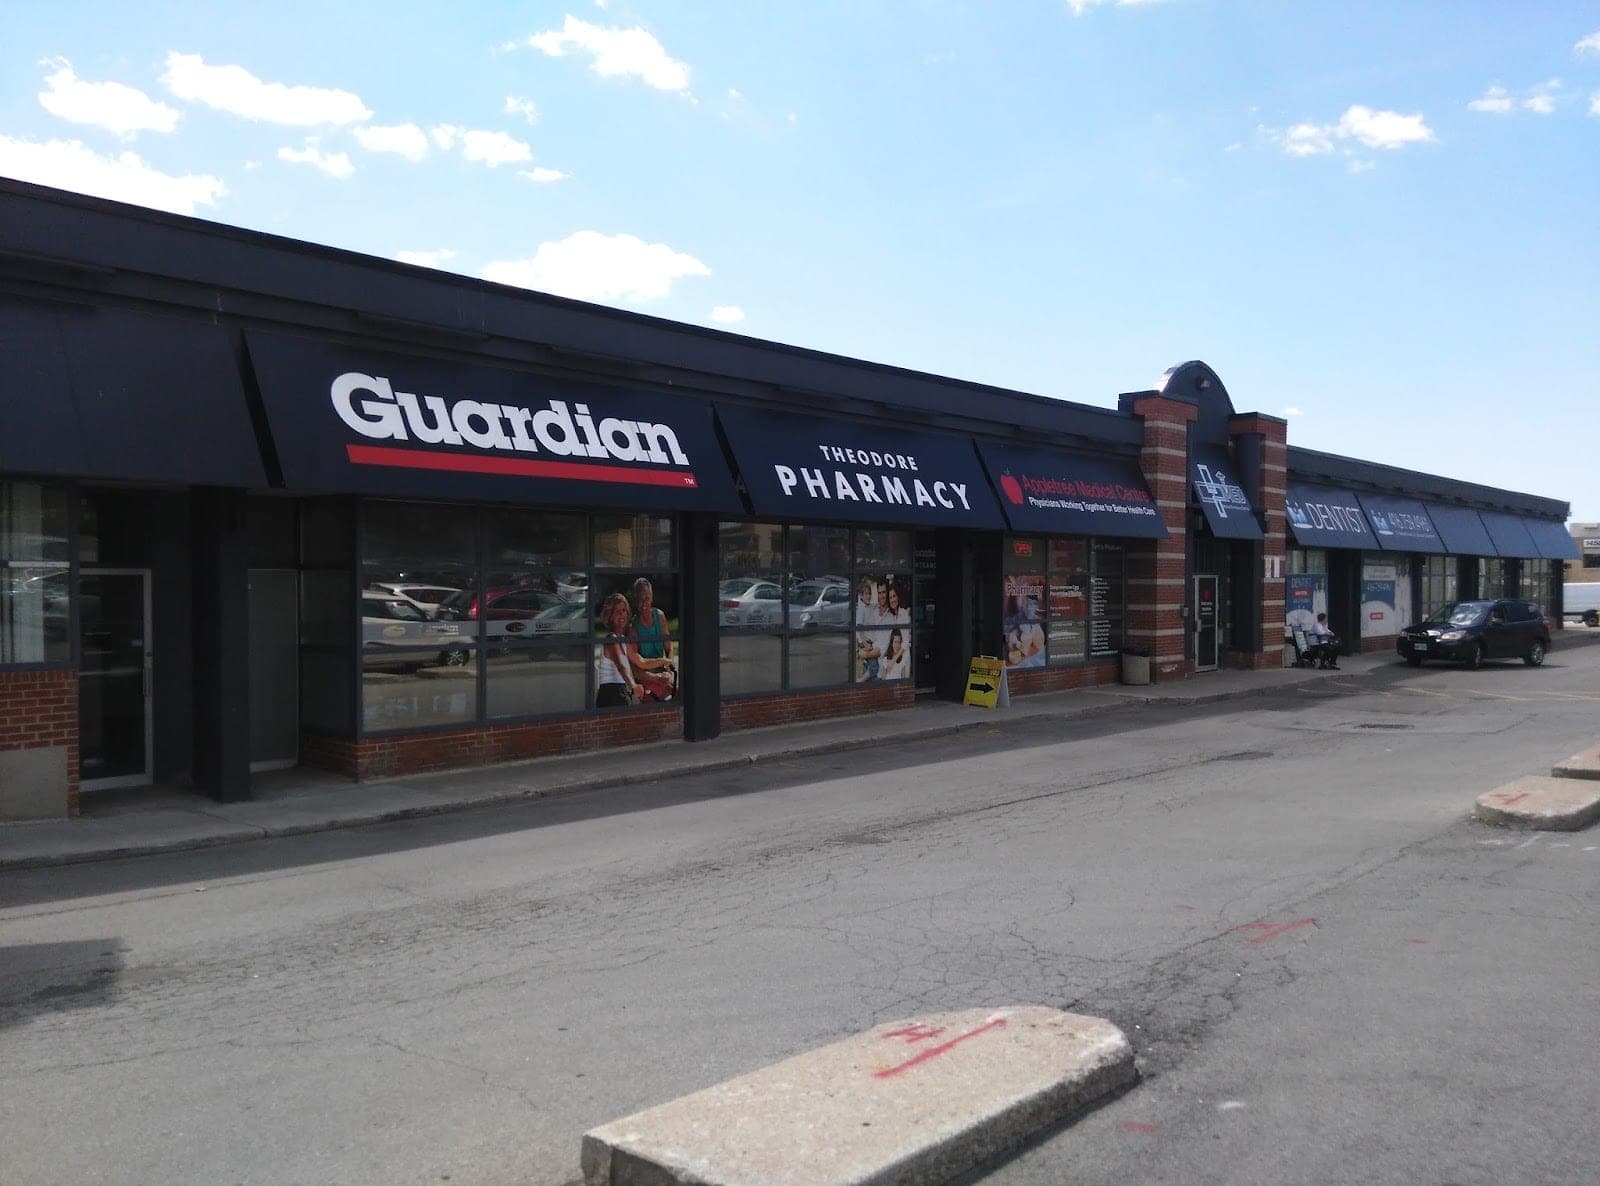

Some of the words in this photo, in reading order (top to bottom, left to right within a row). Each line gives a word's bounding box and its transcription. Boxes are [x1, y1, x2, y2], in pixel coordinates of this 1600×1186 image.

[330, 372, 690, 467] Guardian
[819, 445, 919, 472] THEODORE
[774, 464, 971, 511] PHARMACY
[1077, 479, 1115, 499] Medical
[1028, 496, 1060, 508] Physicians
[1060, 499, 1084, 511] Working
[1305, 502, 1367, 533] DENTIST
